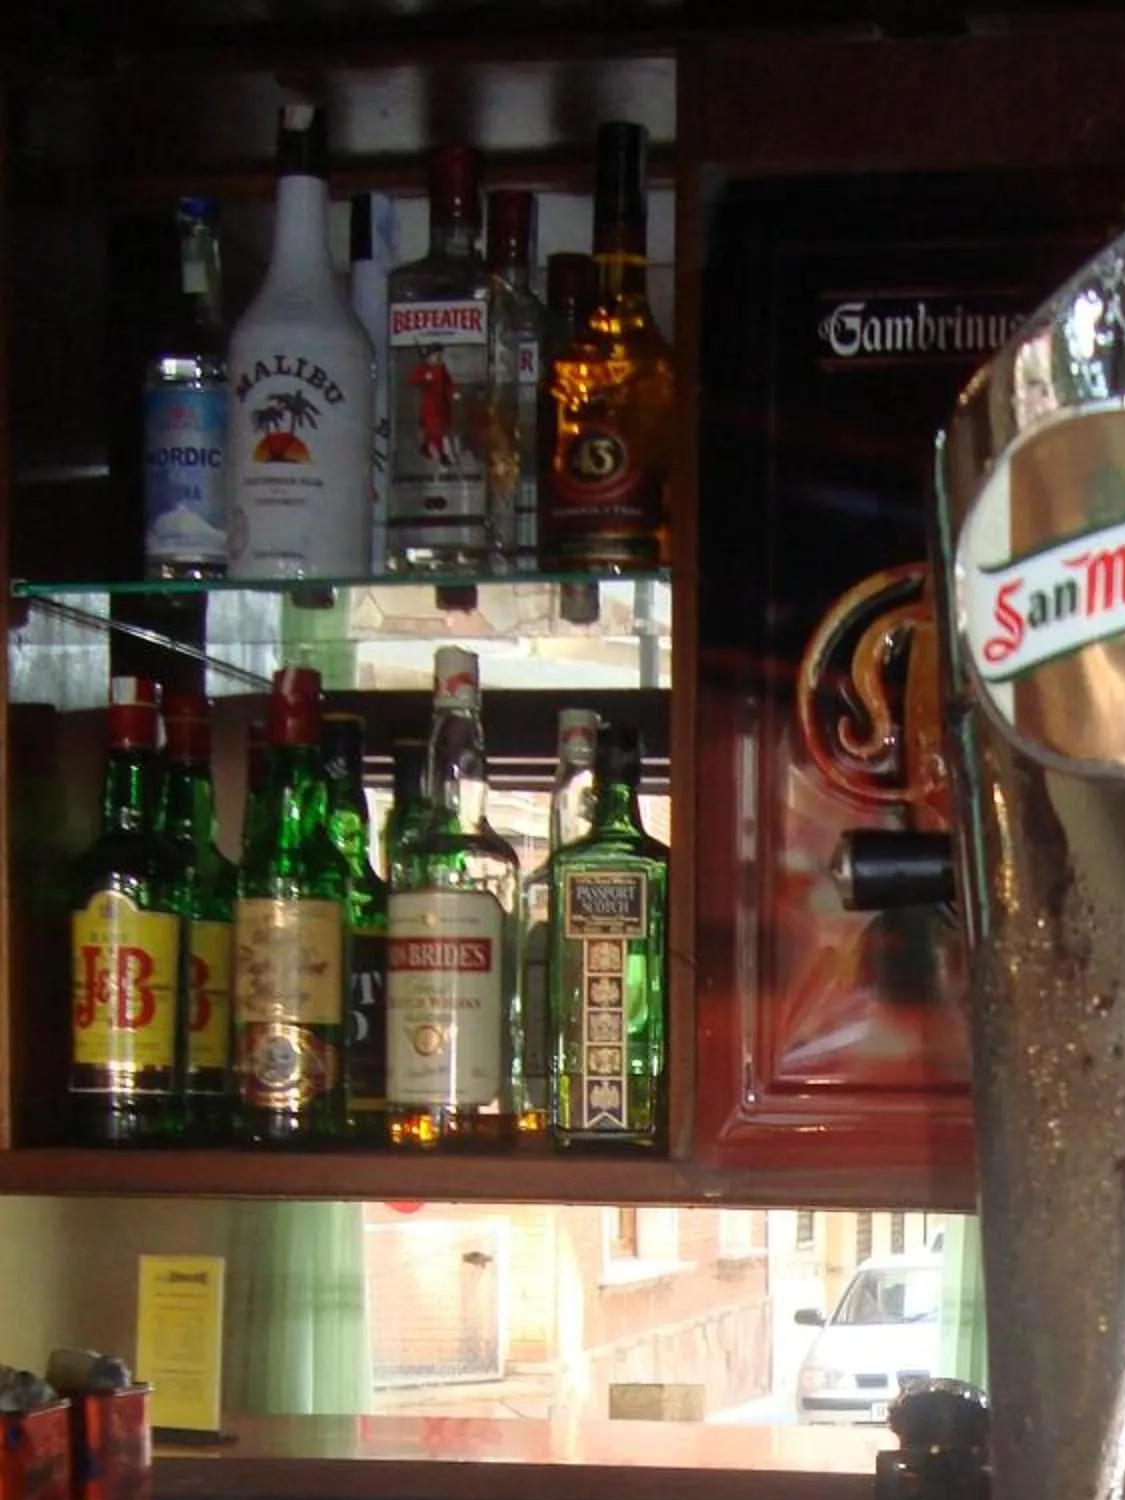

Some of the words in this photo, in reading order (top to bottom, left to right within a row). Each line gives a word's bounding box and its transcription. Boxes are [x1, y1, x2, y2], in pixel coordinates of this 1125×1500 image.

[394, 308, 483, 335] BEEFEATER
[236, 355, 346, 405] MALIBU
[575, 885, 637, 900] PASSPORT
[581, 899, 630, 914] SCOTCH
[75, 945, 157, 1029] J&B
